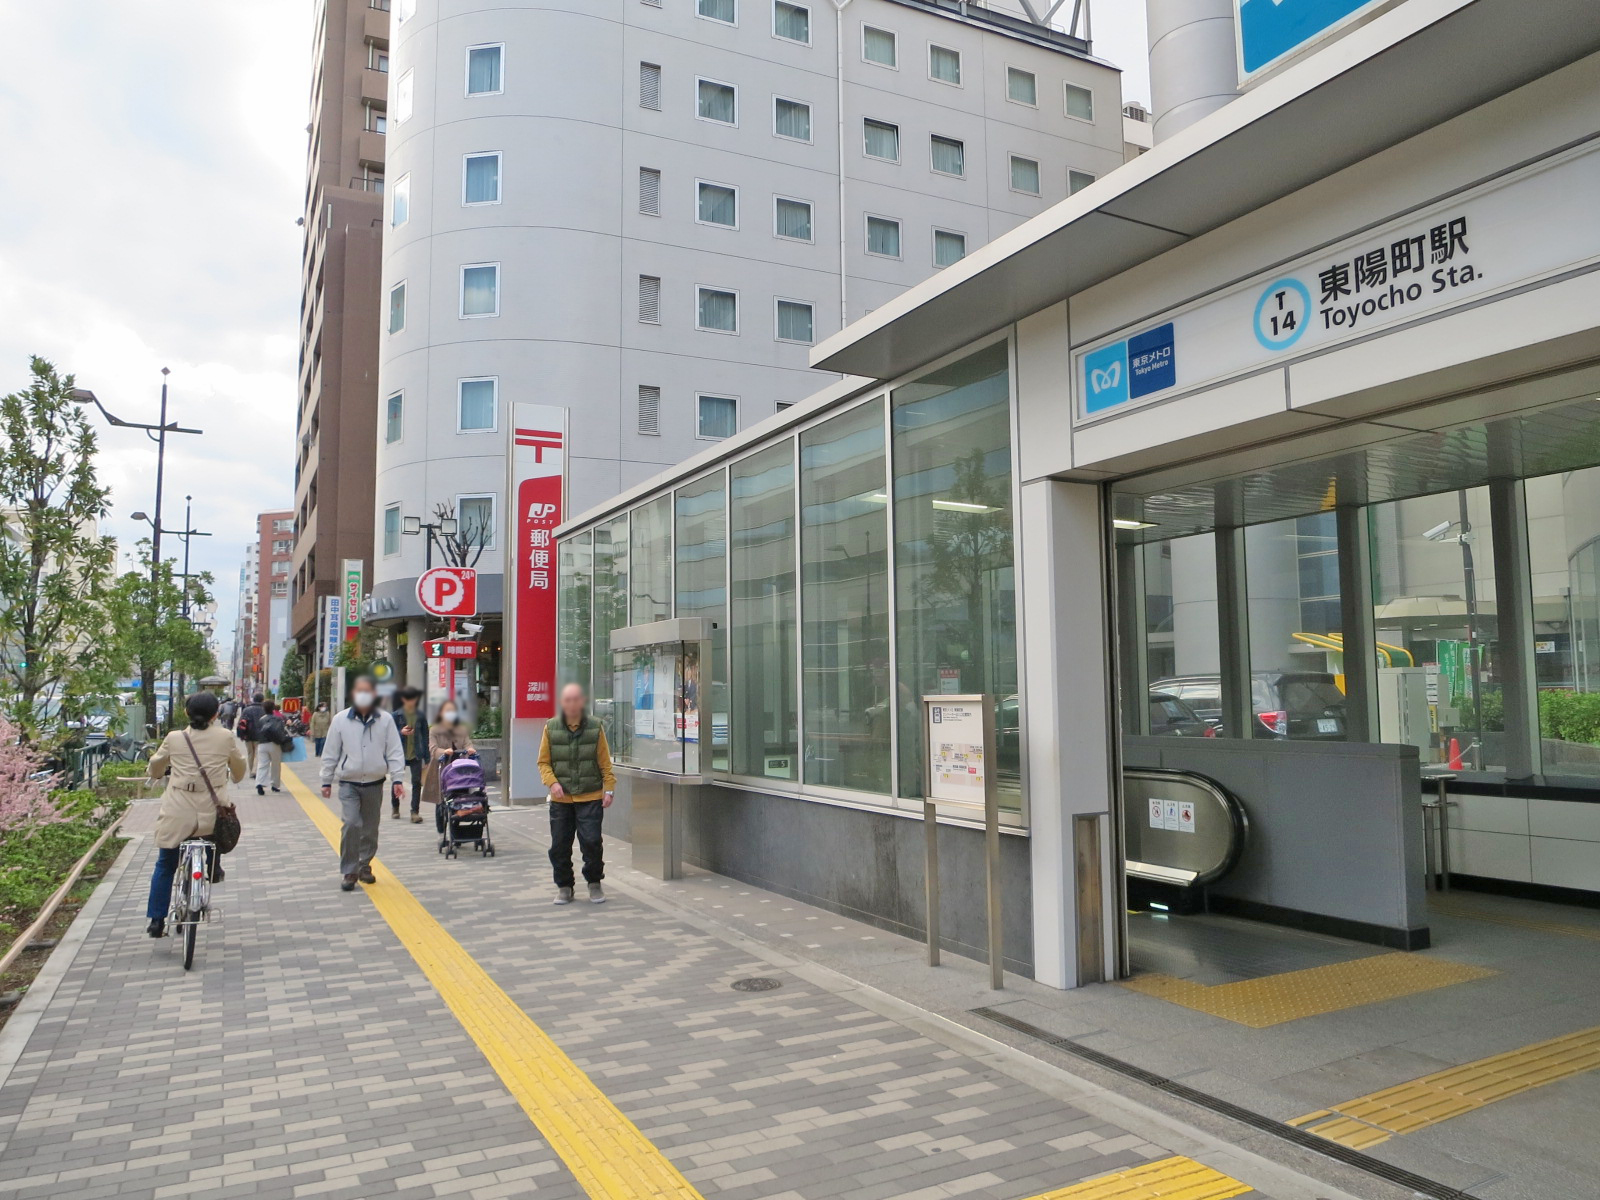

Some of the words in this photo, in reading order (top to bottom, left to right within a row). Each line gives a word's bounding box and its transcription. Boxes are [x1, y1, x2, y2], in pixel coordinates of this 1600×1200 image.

[1318, 216, 1470, 305] 東陽町駅
[1275, 291, 1286, 311] T
[1319, 283, 1422, 330] Toyocho
[1432, 264, 1483, 294] Sta.
[1270, 310, 1297, 336] 14
[1132, 346, 1171, 369] 東京メトロ
[1135, 367, 1151, 376] Tokyo
[1151, 359, 1169, 371] Metro
[528, 528, 550, 590] 郵便局
[434, 577, 457, 607] P
